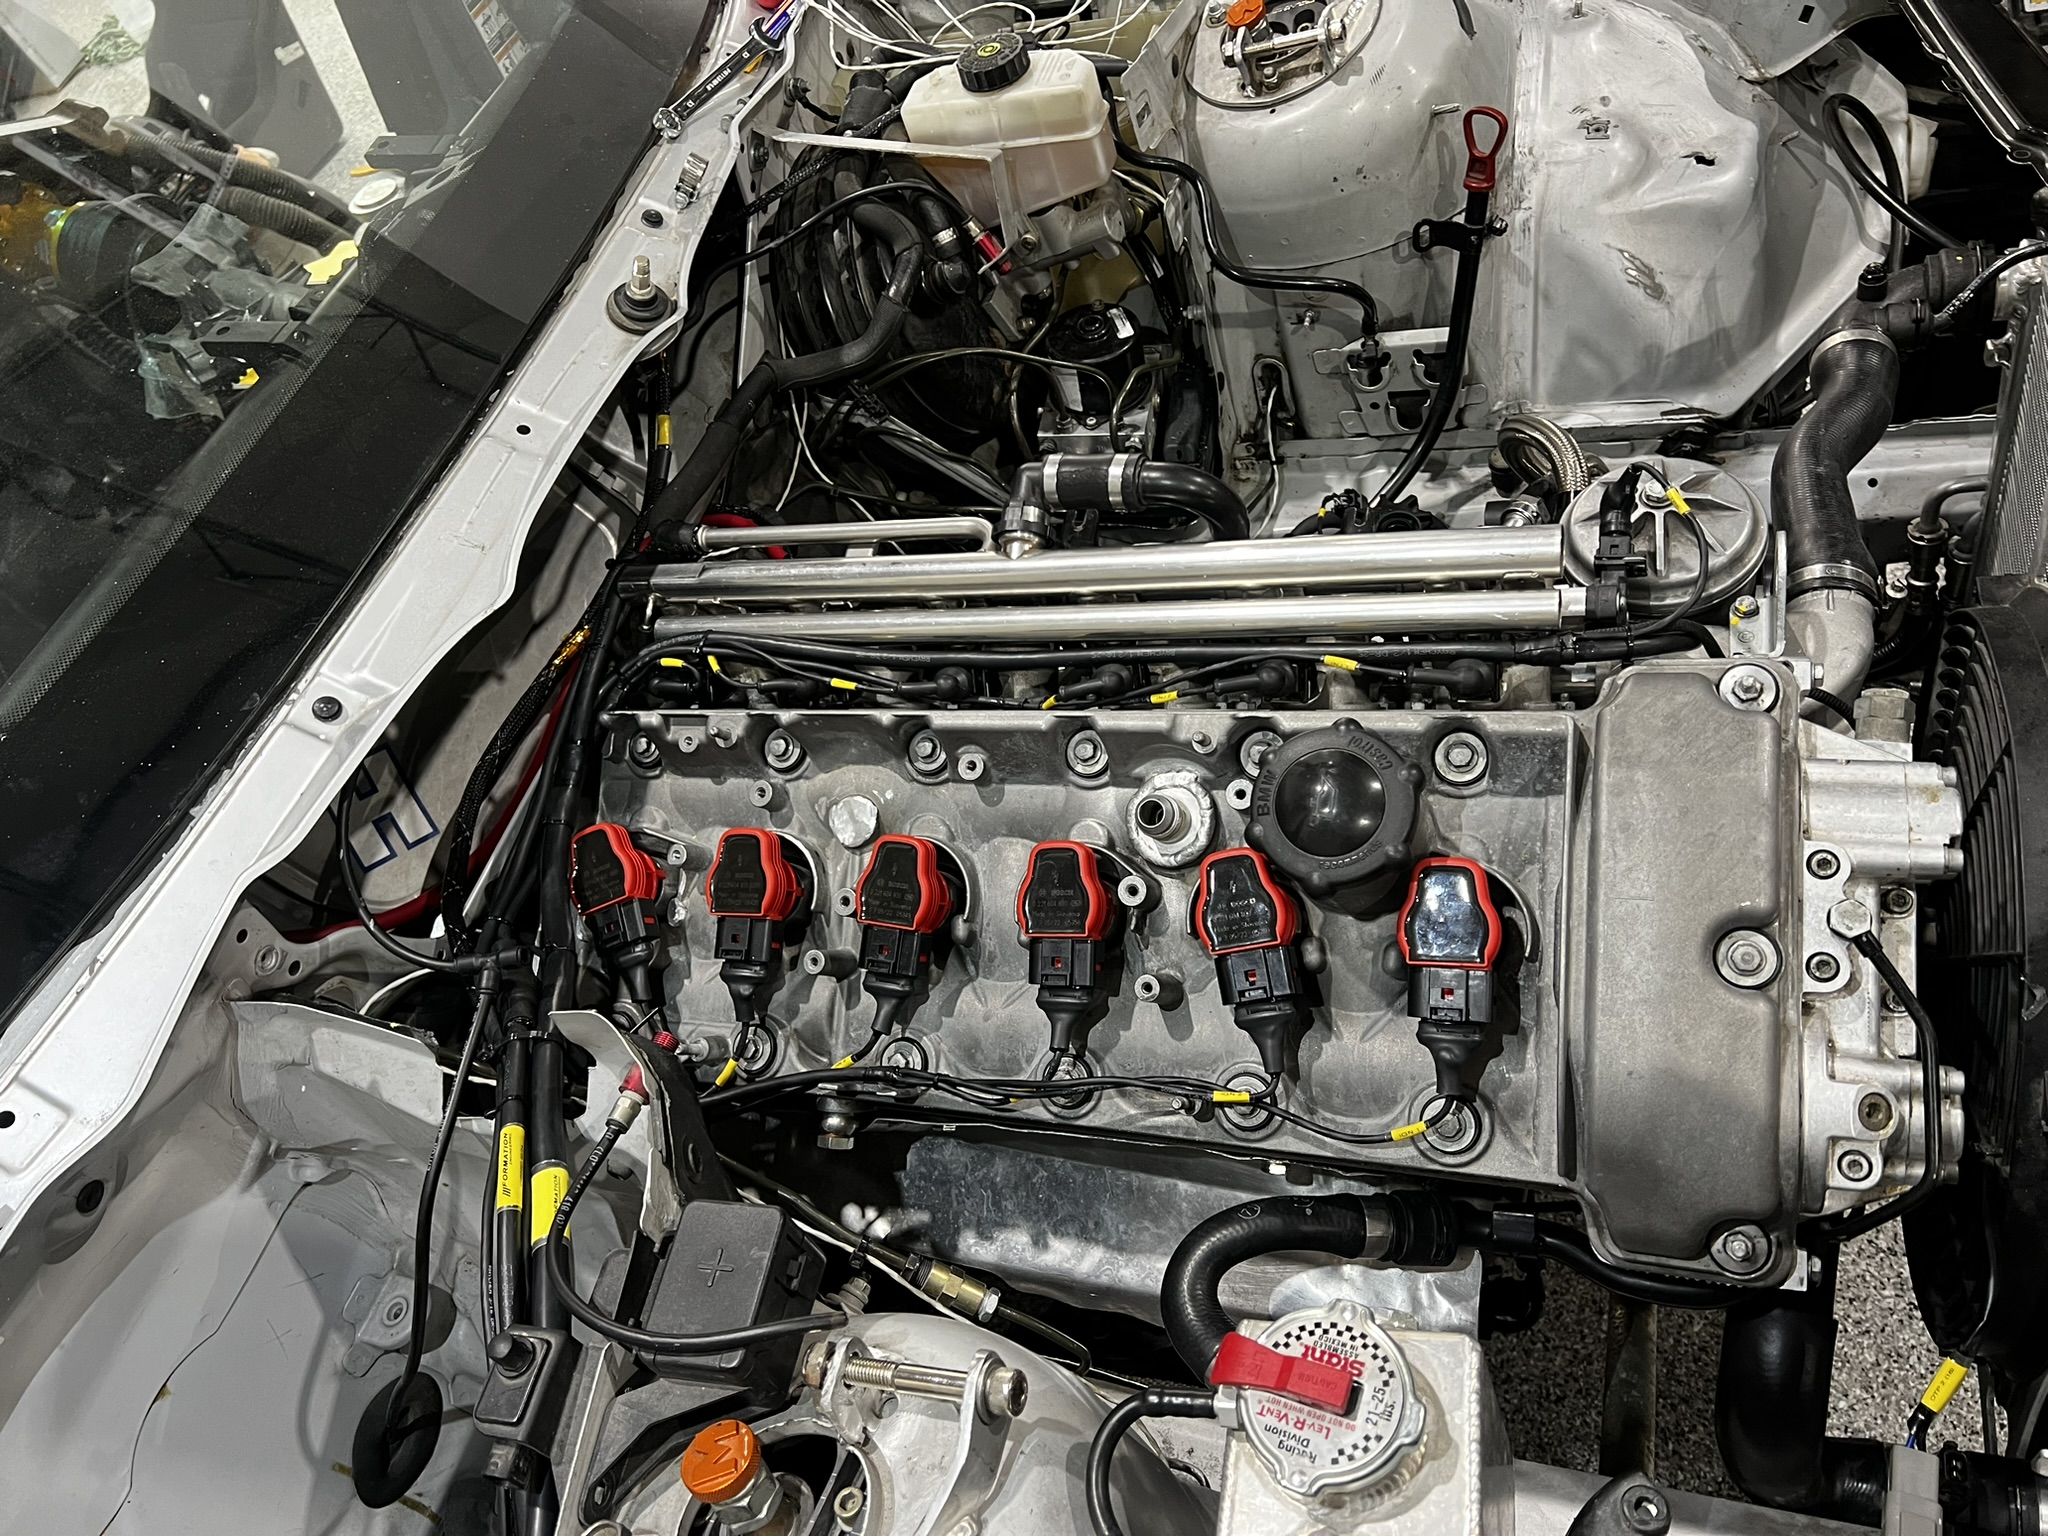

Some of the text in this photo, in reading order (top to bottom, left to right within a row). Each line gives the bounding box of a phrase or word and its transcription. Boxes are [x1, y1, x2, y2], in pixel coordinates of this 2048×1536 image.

[1256, 769, 1279, 818] BMW
[1318, 839, 1383, 871] recommends
[1312, 1339, 1360, 1360] ASSEMBLED
[1318, 1334, 1359, 1352] IN MEXICO
[1300, 1344, 1366, 1379] Stant
[1266, 1395, 1357, 1433] DO NOT OPEN WHEN HOT
[1365, 1386, 1387, 1427] 21-25
[1263, 1423, 1311, 1449] Division
[1277, 1439, 1318, 1464] Racing
